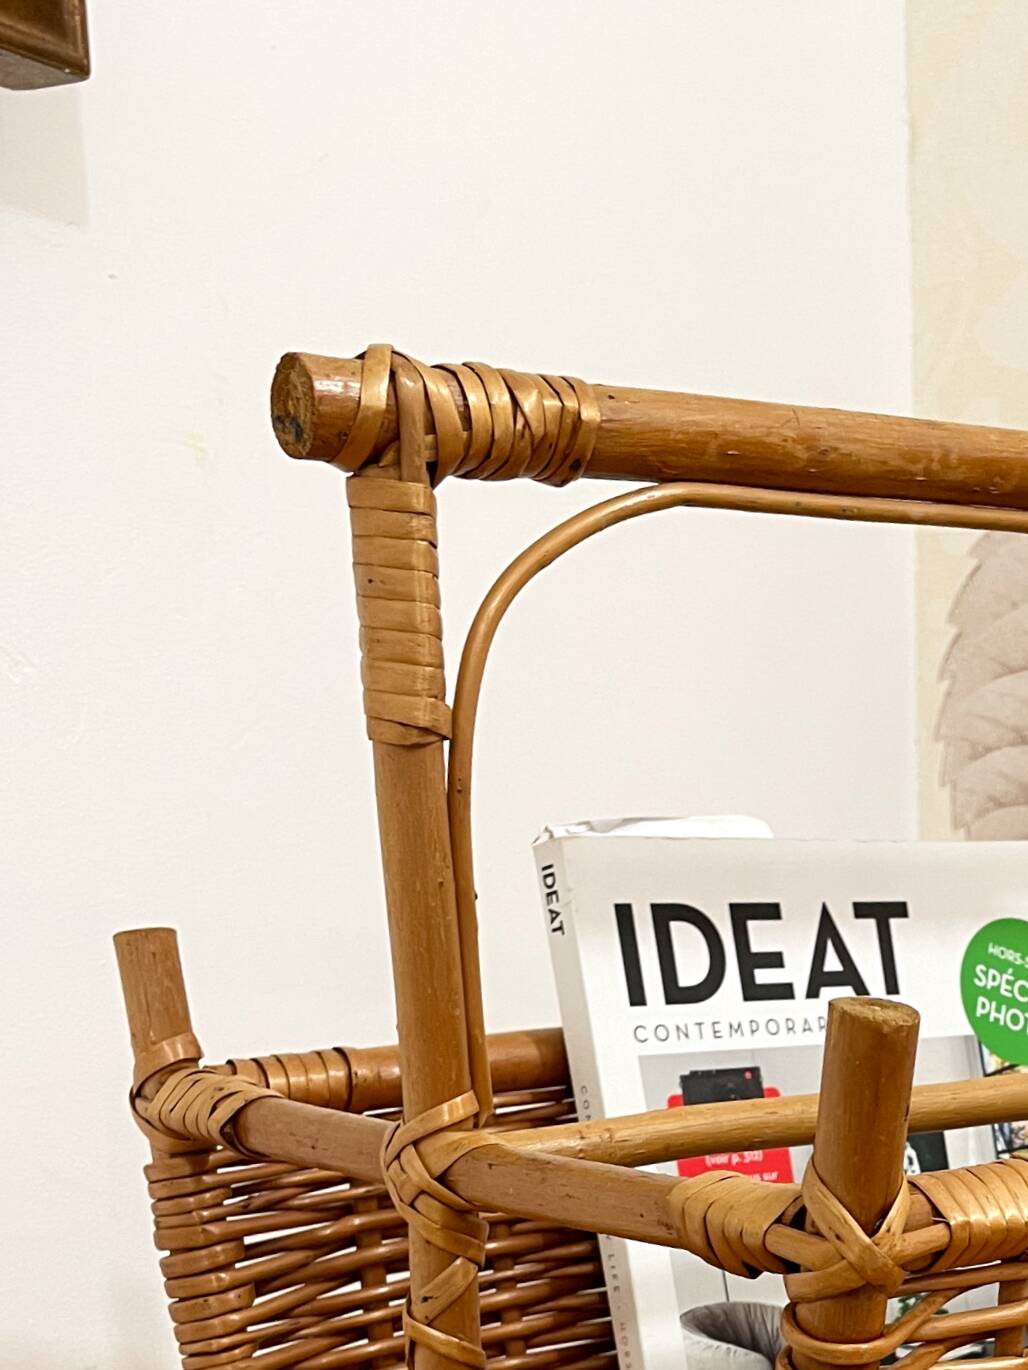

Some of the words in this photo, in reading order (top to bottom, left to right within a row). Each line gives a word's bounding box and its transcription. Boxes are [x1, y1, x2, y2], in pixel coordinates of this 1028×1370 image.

[541, 863, 565, 936] IDEAT
[613, 901, 909, 1007] IDEAT
[633, 1015, 827, 1044] CONTEMPORAR
